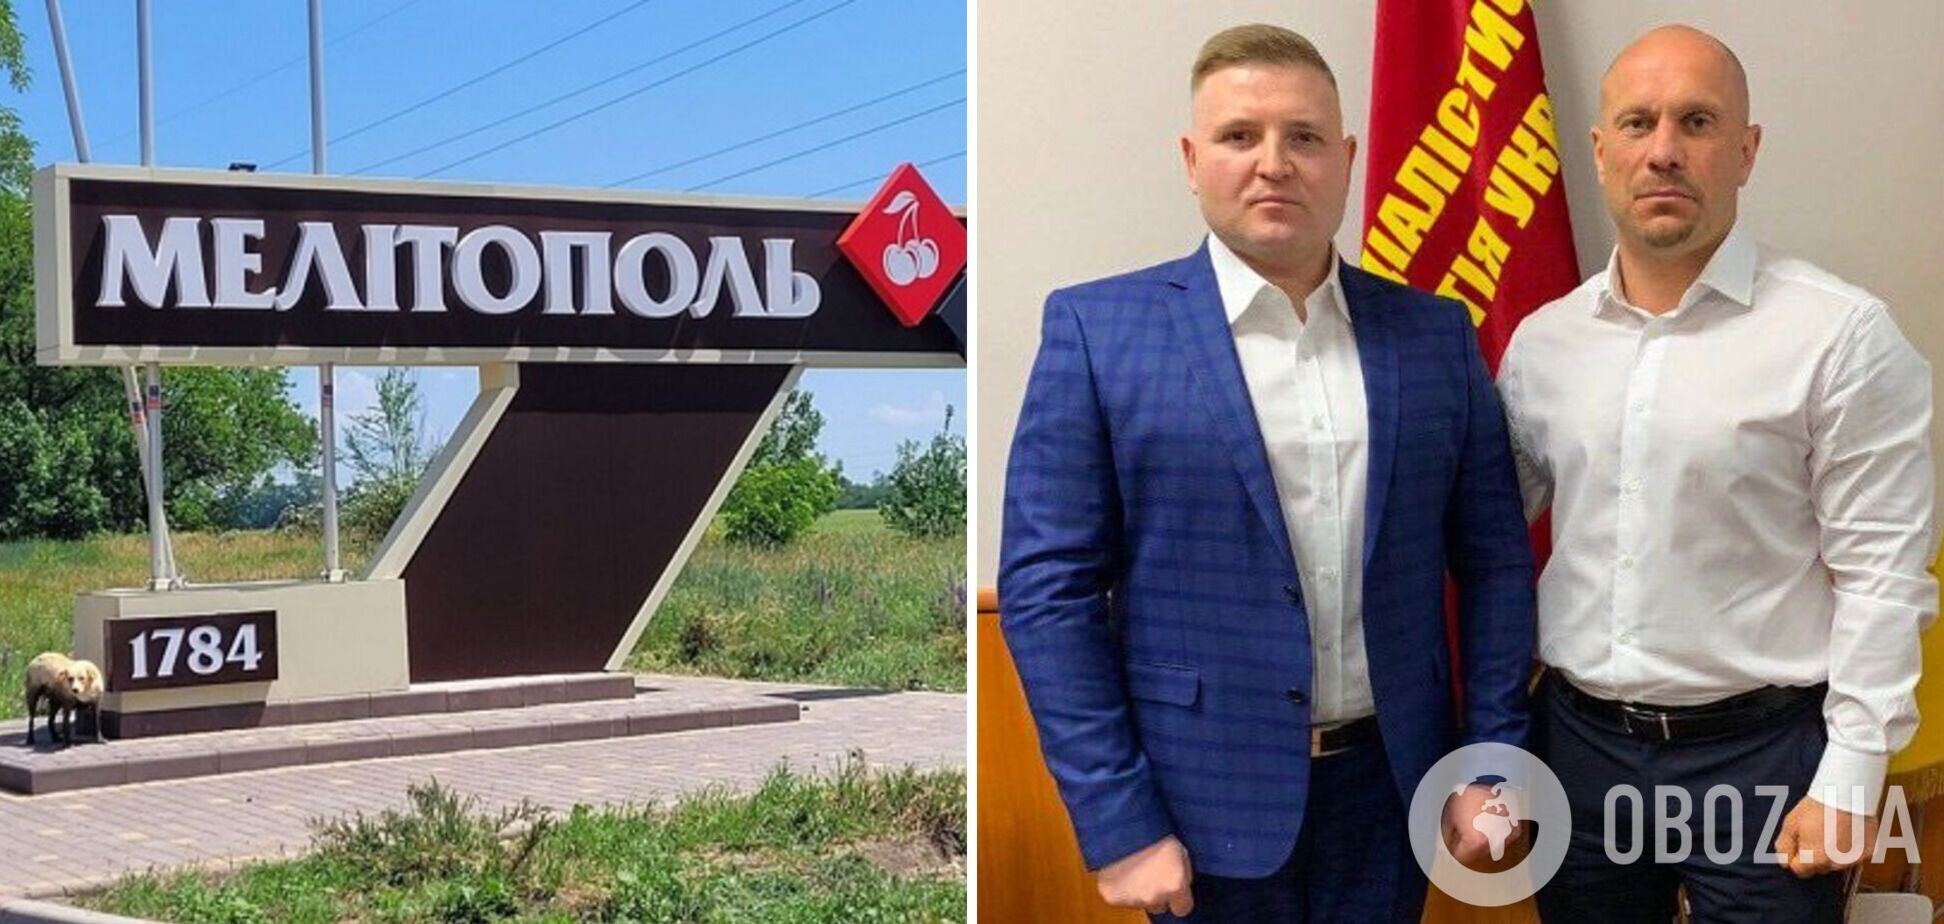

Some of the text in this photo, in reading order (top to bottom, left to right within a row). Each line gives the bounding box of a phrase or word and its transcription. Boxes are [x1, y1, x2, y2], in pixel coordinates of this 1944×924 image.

[1361, 0, 1525, 286] ІАЛІСТИ
[96, 214, 821, 319] МЕЛІТОПОЛЬ
[129, 623, 263, 680] 1784
